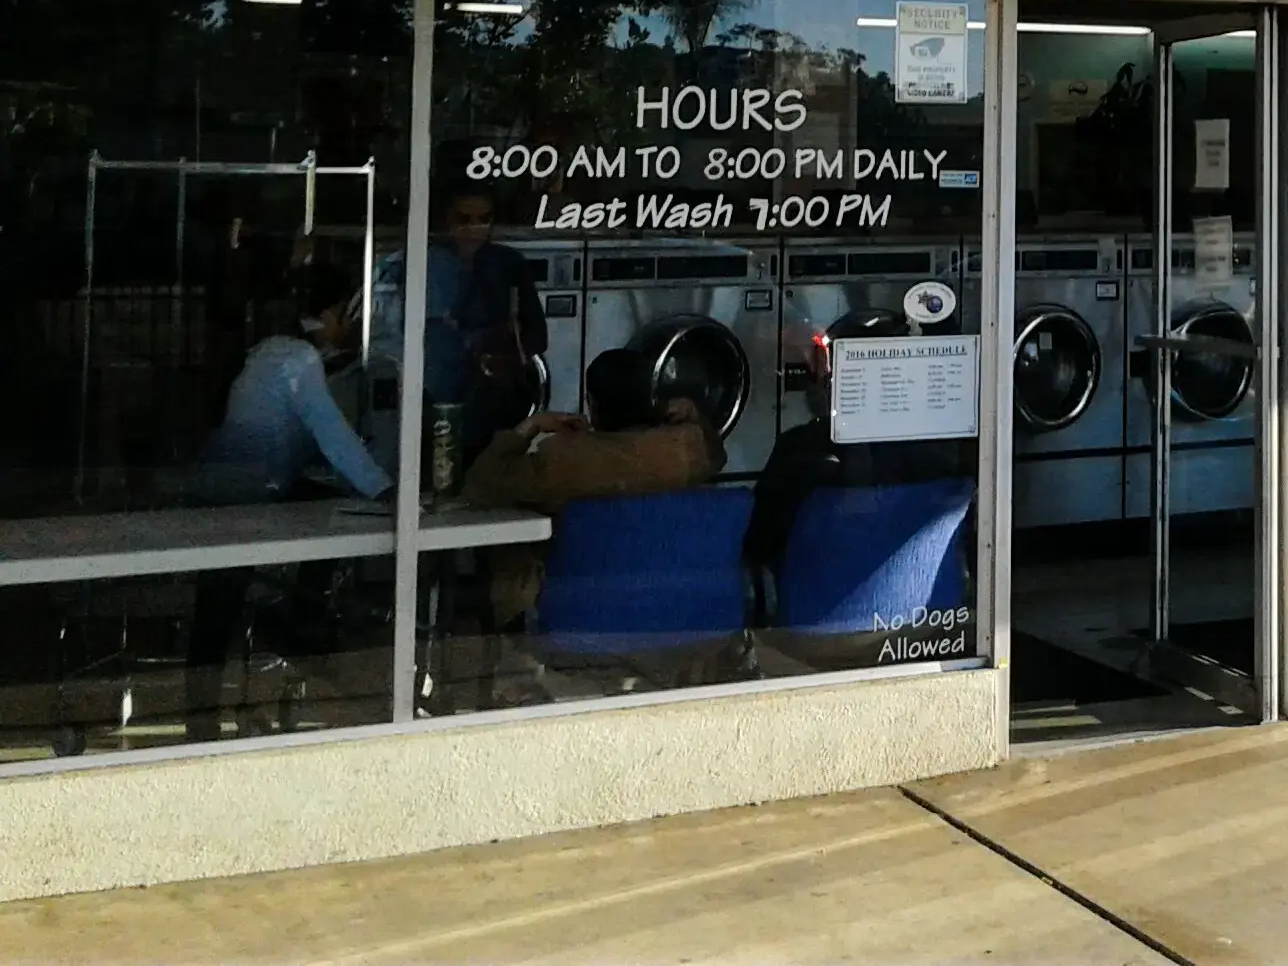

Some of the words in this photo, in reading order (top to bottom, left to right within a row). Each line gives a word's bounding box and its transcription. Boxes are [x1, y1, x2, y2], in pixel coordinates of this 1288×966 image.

[914, 18, 952, 30] NOTICE
[635, 86, 808, 132] HOURS
[465, 144, 558, 180] 8:00
[566, 146, 626, 179] AM
[635, 146, 681, 179] TO
[703, 147, 786, 181] 8:00
[795, 149, 843, 180] PM
[854, 149, 948, 181] DAILY
[534, 194, 627, 230] Last
[635, 194, 733, 229] Wash
[748, 195, 831, 231] 7:00
[836, 194, 892, 228] PM
[867, 347, 912, 358] HOLIDAY
[916, 344, 968, 356] SCHEDULE
[873, 611, 904, 633] No
[911, 605, 970, 631] Dogs
[877, 630, 966, 663] Allowed
